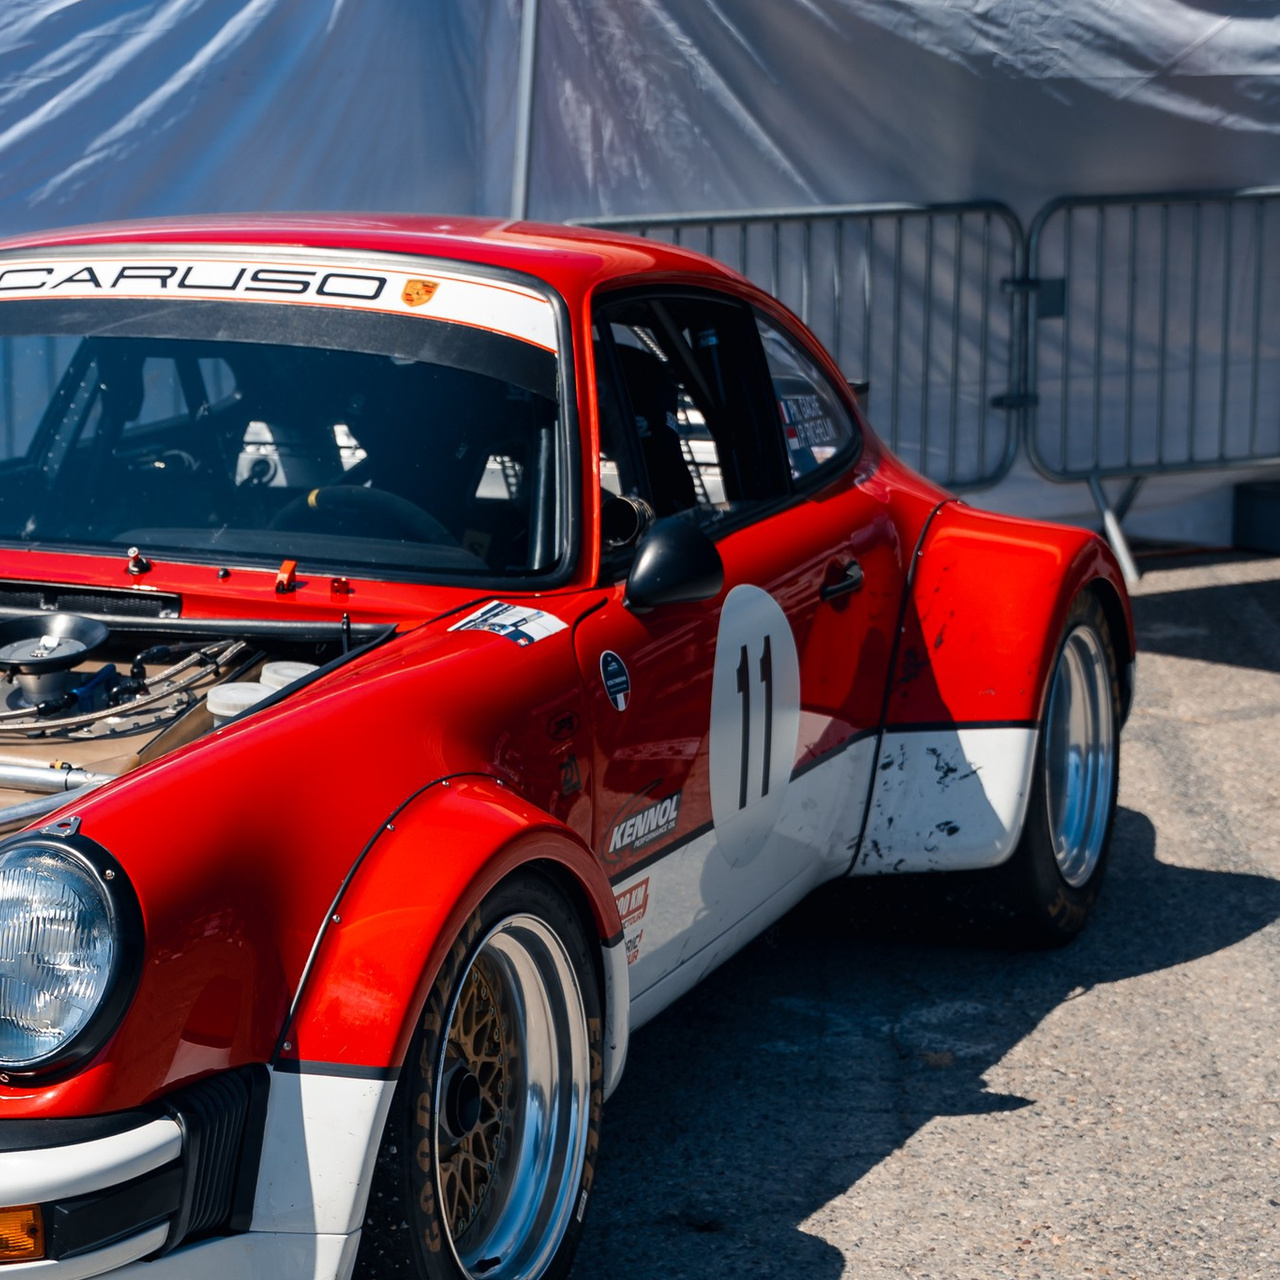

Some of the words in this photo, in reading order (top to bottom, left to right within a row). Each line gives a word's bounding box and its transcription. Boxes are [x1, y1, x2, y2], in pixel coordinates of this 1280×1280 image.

[736, 634, 773, 811] 11
[608, 793, 679, 854] KENNOL
[630, 884, 646, 911] KM
